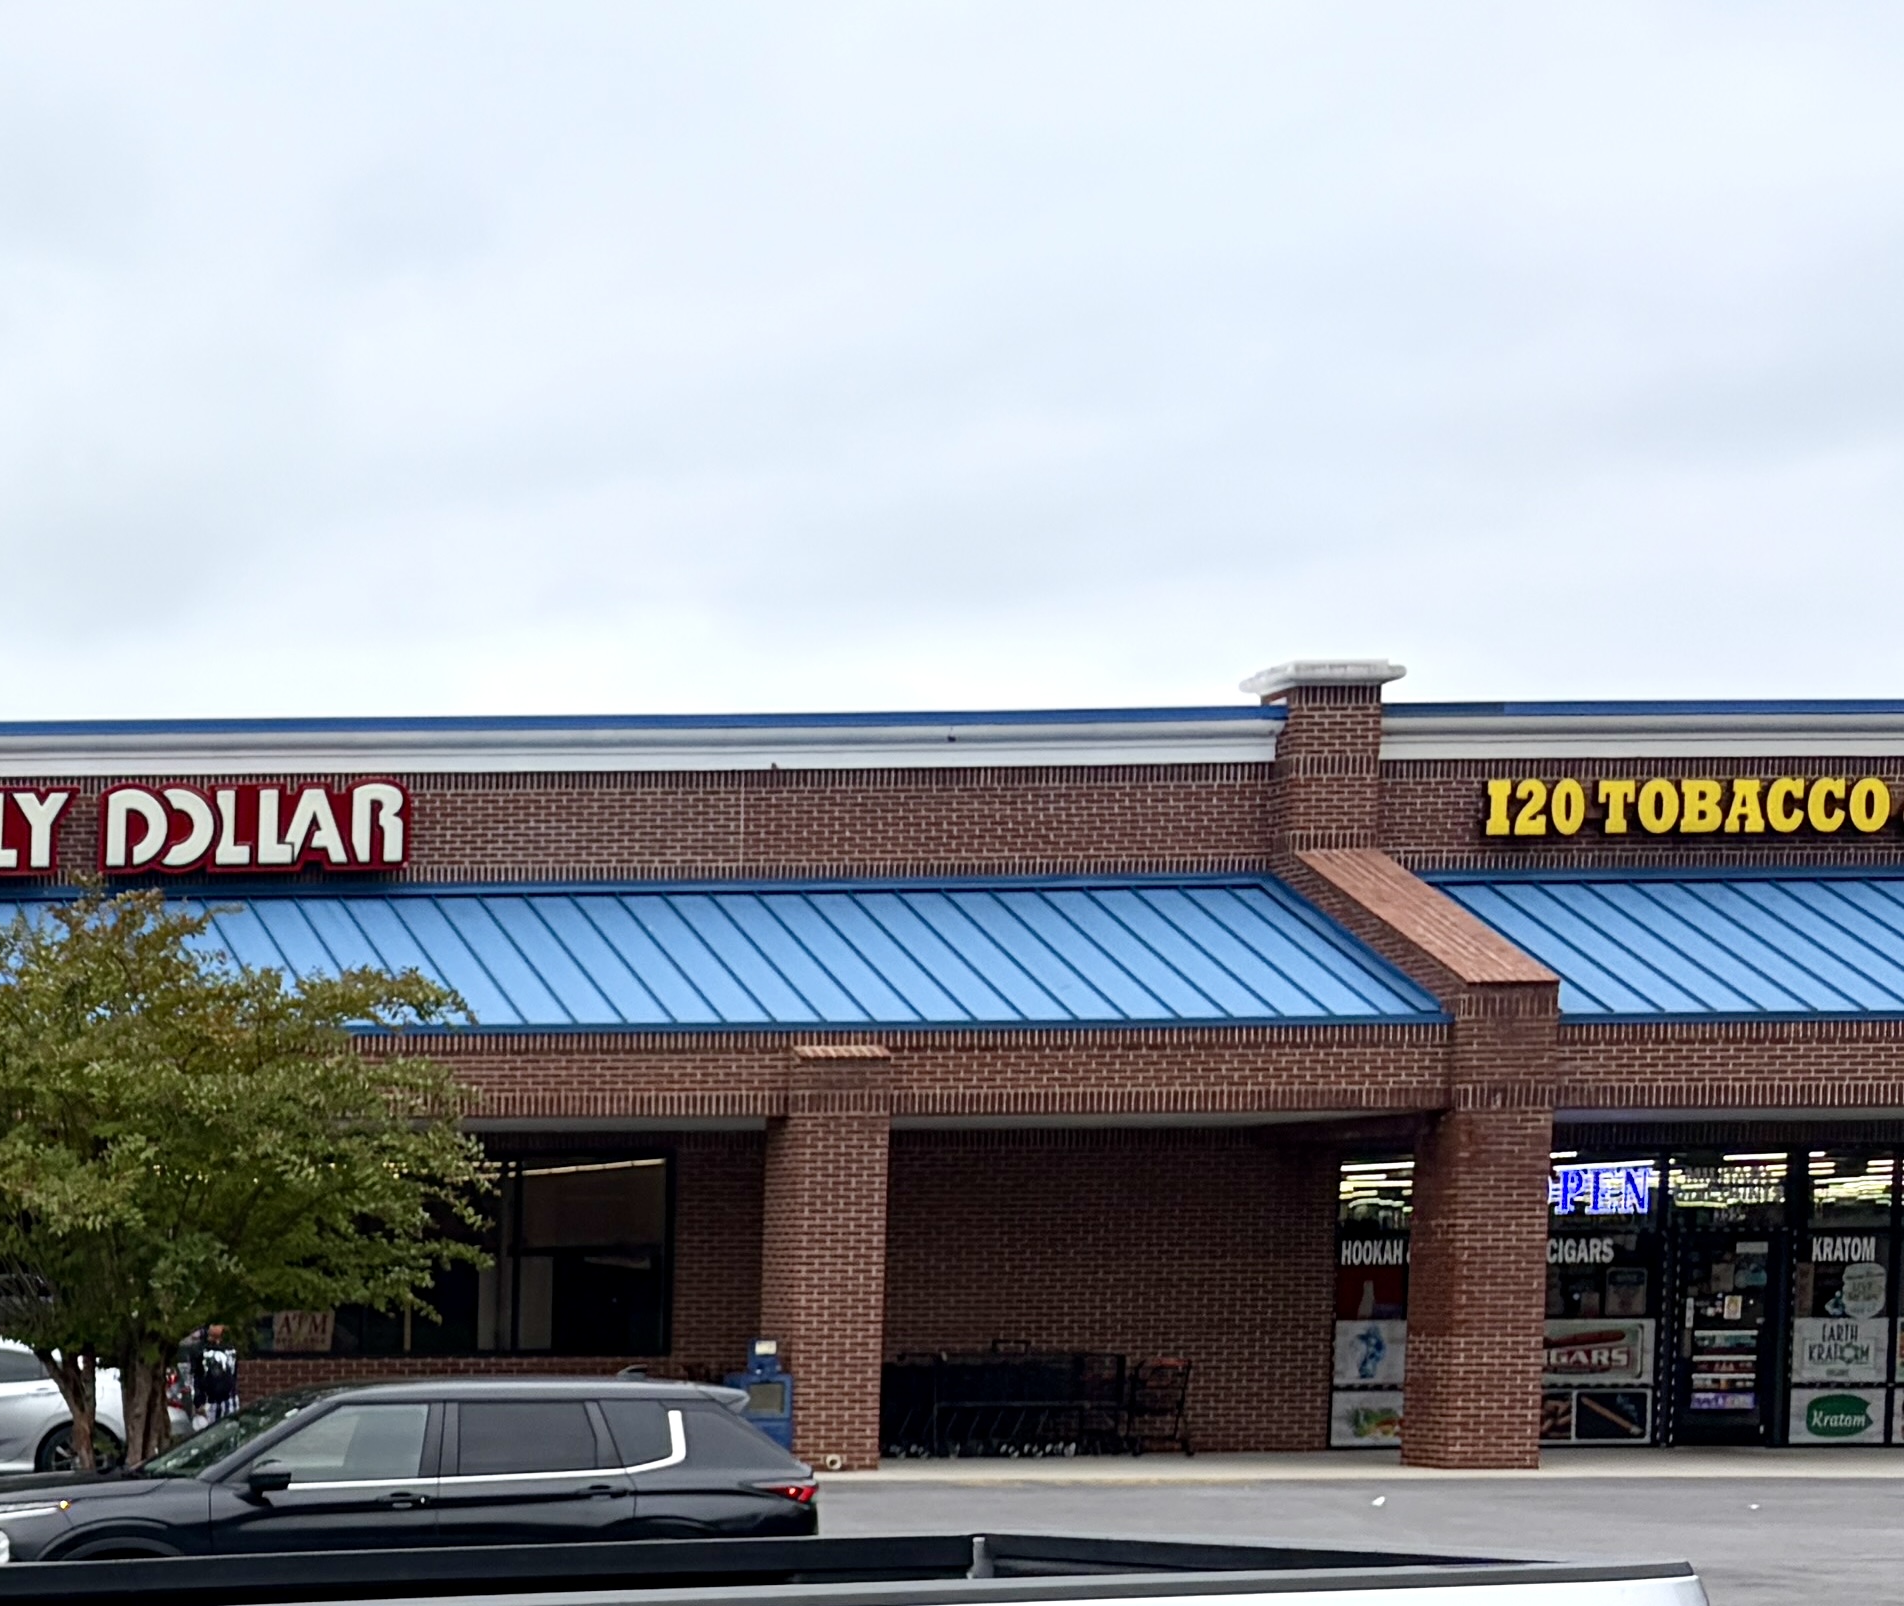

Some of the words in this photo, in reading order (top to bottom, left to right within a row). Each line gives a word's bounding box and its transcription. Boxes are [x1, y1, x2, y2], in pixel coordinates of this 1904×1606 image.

[1599, 777, 1890, 834] TOBACCO
[106, 785, 403, 867] DOLLAR
[1548, 1167, 1650, 1215] PEN
[1341, 1240, 1403, 1266] HOOKAH
[1546, 1238, 1614, 1264] CIGARS
[1812, 1236, 1876, 1262] KRATOM
[1822, 1323, 1858, 1342] EARTH
[1544, 1348, 1628, 1367] IGARS
[1812, 1409, 1865, 1427] Kratom
